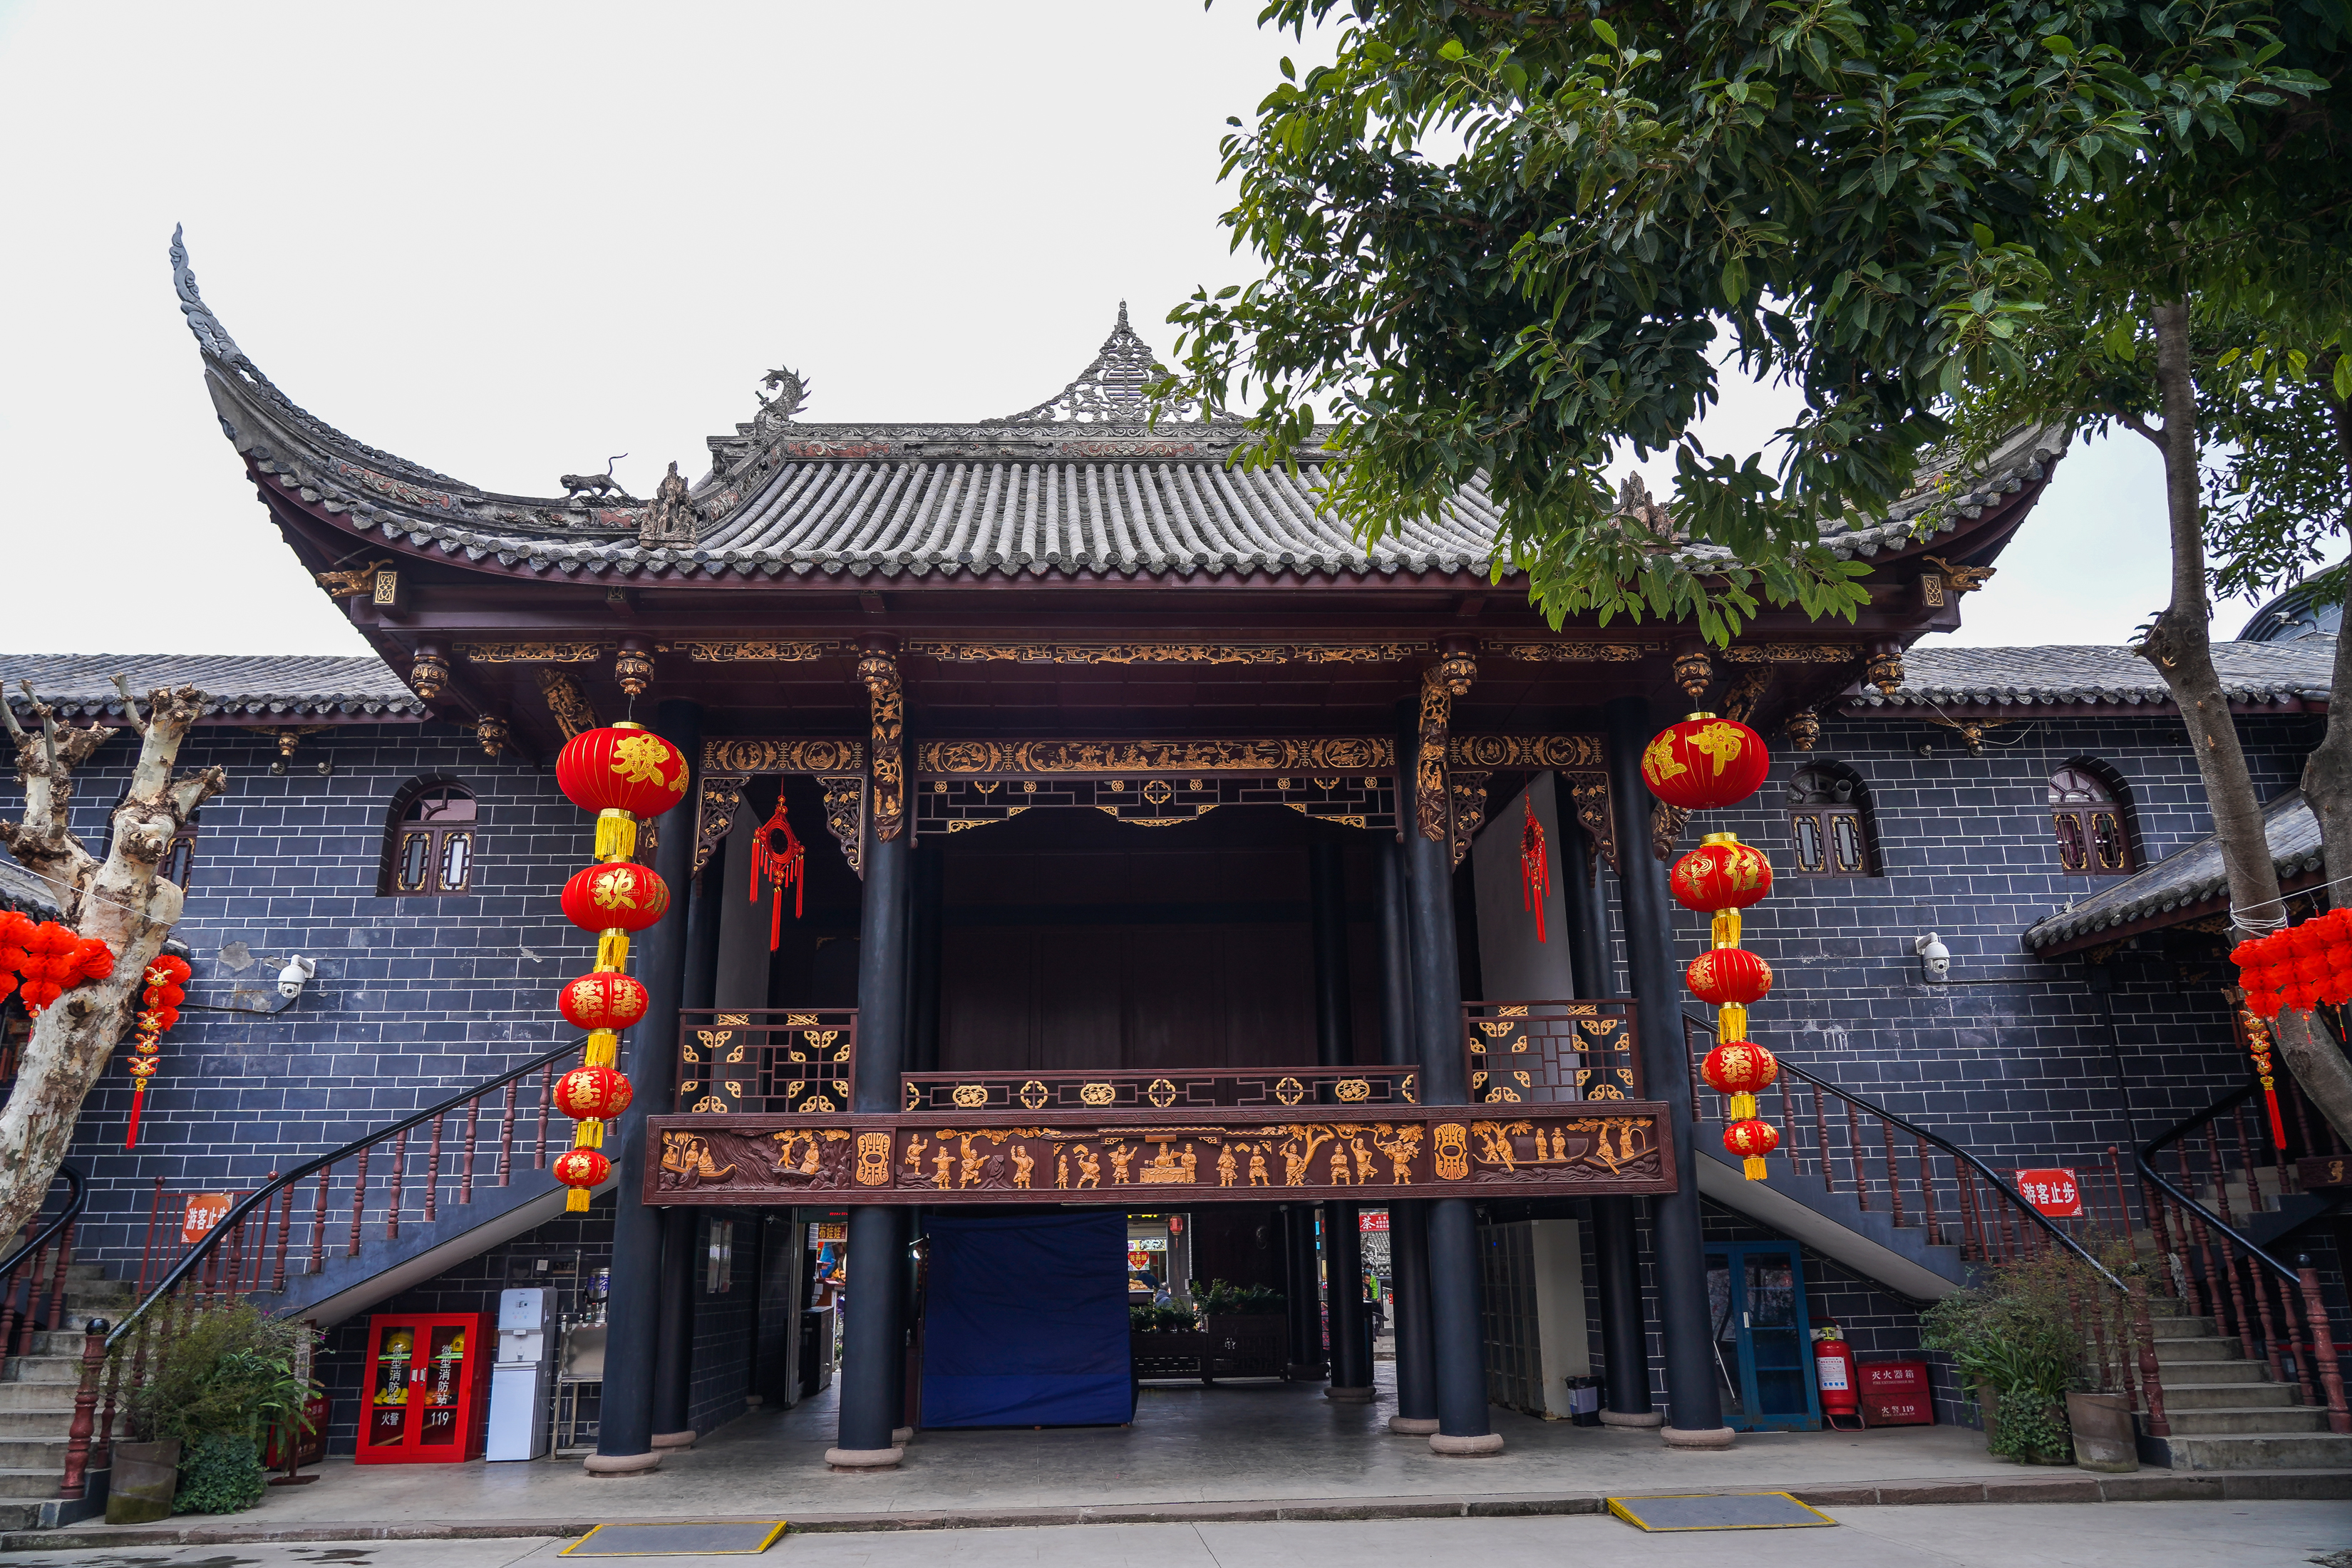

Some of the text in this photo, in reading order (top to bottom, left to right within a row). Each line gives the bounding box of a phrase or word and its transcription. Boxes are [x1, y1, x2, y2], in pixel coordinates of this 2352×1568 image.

[594, 867, 636, 909] 欢
[2022, 1181, 2075, 1205] 游客止步
[819, 1226, 841, 1239] 布娃娃
[387, 1345, 403, 1405] 微型消防站
[436, 1344, 453, 1406] 微型消防站
[1871, 1369, 1914, 1381] 灭火器箱
[1882, 1405, 1899, 1414] 火警
[381, 1413, 399, 1425] 火警
[431, 1412, 449, 1425] 119
